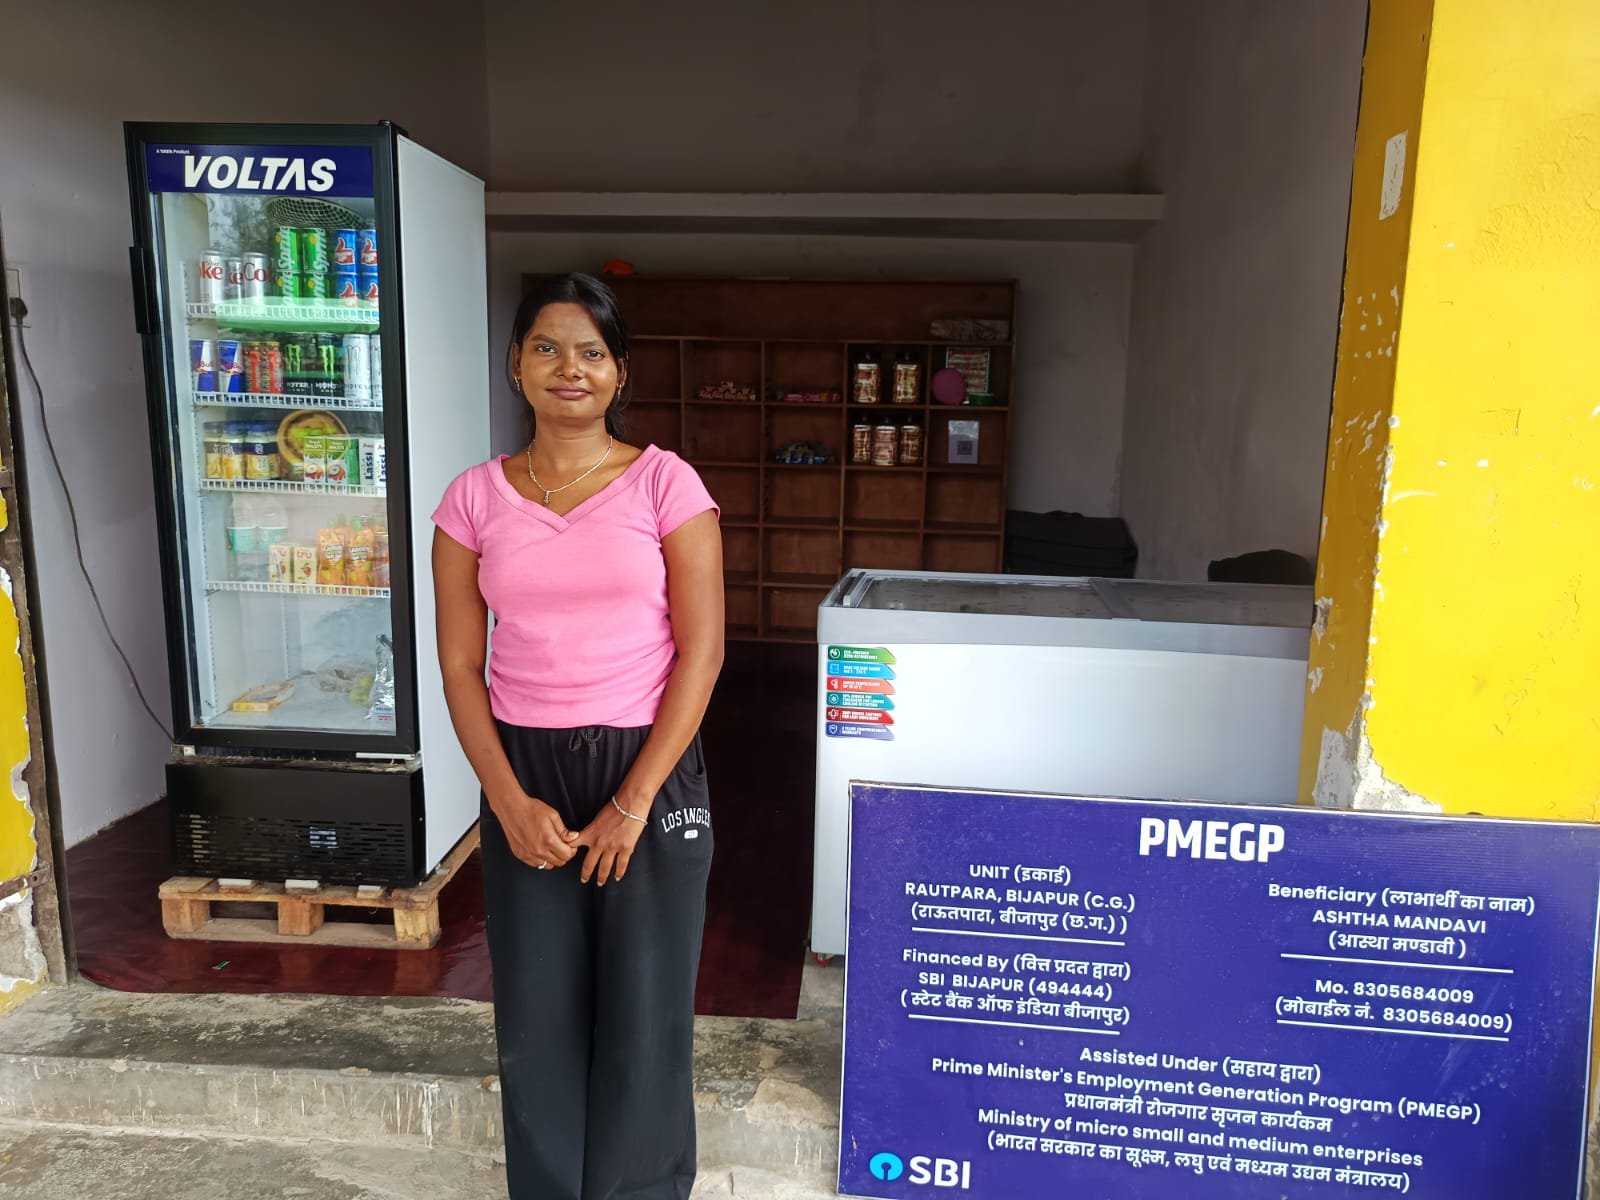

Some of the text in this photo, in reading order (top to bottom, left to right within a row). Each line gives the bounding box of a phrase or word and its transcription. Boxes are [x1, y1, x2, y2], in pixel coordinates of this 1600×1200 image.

[183, 155, 337, 192] VOLTAS
[661, 810, 682, 833] LOS
[1139, 817, 1285, 863] PMEGP
[970, 864, 1071, 886] UNIT (इकाई)
[905, 882, 1135, 913] RAUTPARA, BIJAPUR (C.G.)
[1269, 884, 1535, 916] Beneficiary (लाभार्थी का नाम)
[912, 901, 995, 925] (राऊतपारा,
[999, 906, 1059, 931] बीजापुर
[1312, 910, 1486, 933] ASHTHA MANDAVI
[1329, 930, 1390, 950] (आस्था
[903, 948, 1131, 981] Financed By (वित्त प्रदत द्वारा)
[919, 972, 1112, 1002] SBI BIJAPUR (494444)
[1316, 980, 1473, 1003] Mo. 8305684009
[911, 989, 942, 1006] स्टेट
[945, 990, 974, 1009] बैंक
[977, 994, 1014, 1012] ऑफ
[1016, 997, 1061, 1016] इंडिया
[1063, 1001, 1130, 1026] बीजापुर)
[1276, 996, 1512, 1033] (मोबाईल नं. 8305684009)
[1080, 1048, 1321, 1085] Assisted Under (सहाय द्वारा)
[932, 1058, 1480, 1124] Prime Minister's Employment Generation Program (PMEGP)
[1064, 1093, 1144, 1114] प्रधानमंत्री
[1146, 1097, 1208, 1120] रोजगार
[1210, 1107, 1258, 1128] सृजन
[978, 1109, 1423, 1166] Ministry of micro small and medium enterprises
[909, 1156, 970, 1189] SBI
[988, 1130, 1410, 1193] (भारत सरकार का सूक्ष्म, लघु एवं मध्यम उद्यम मंत्रालय)
